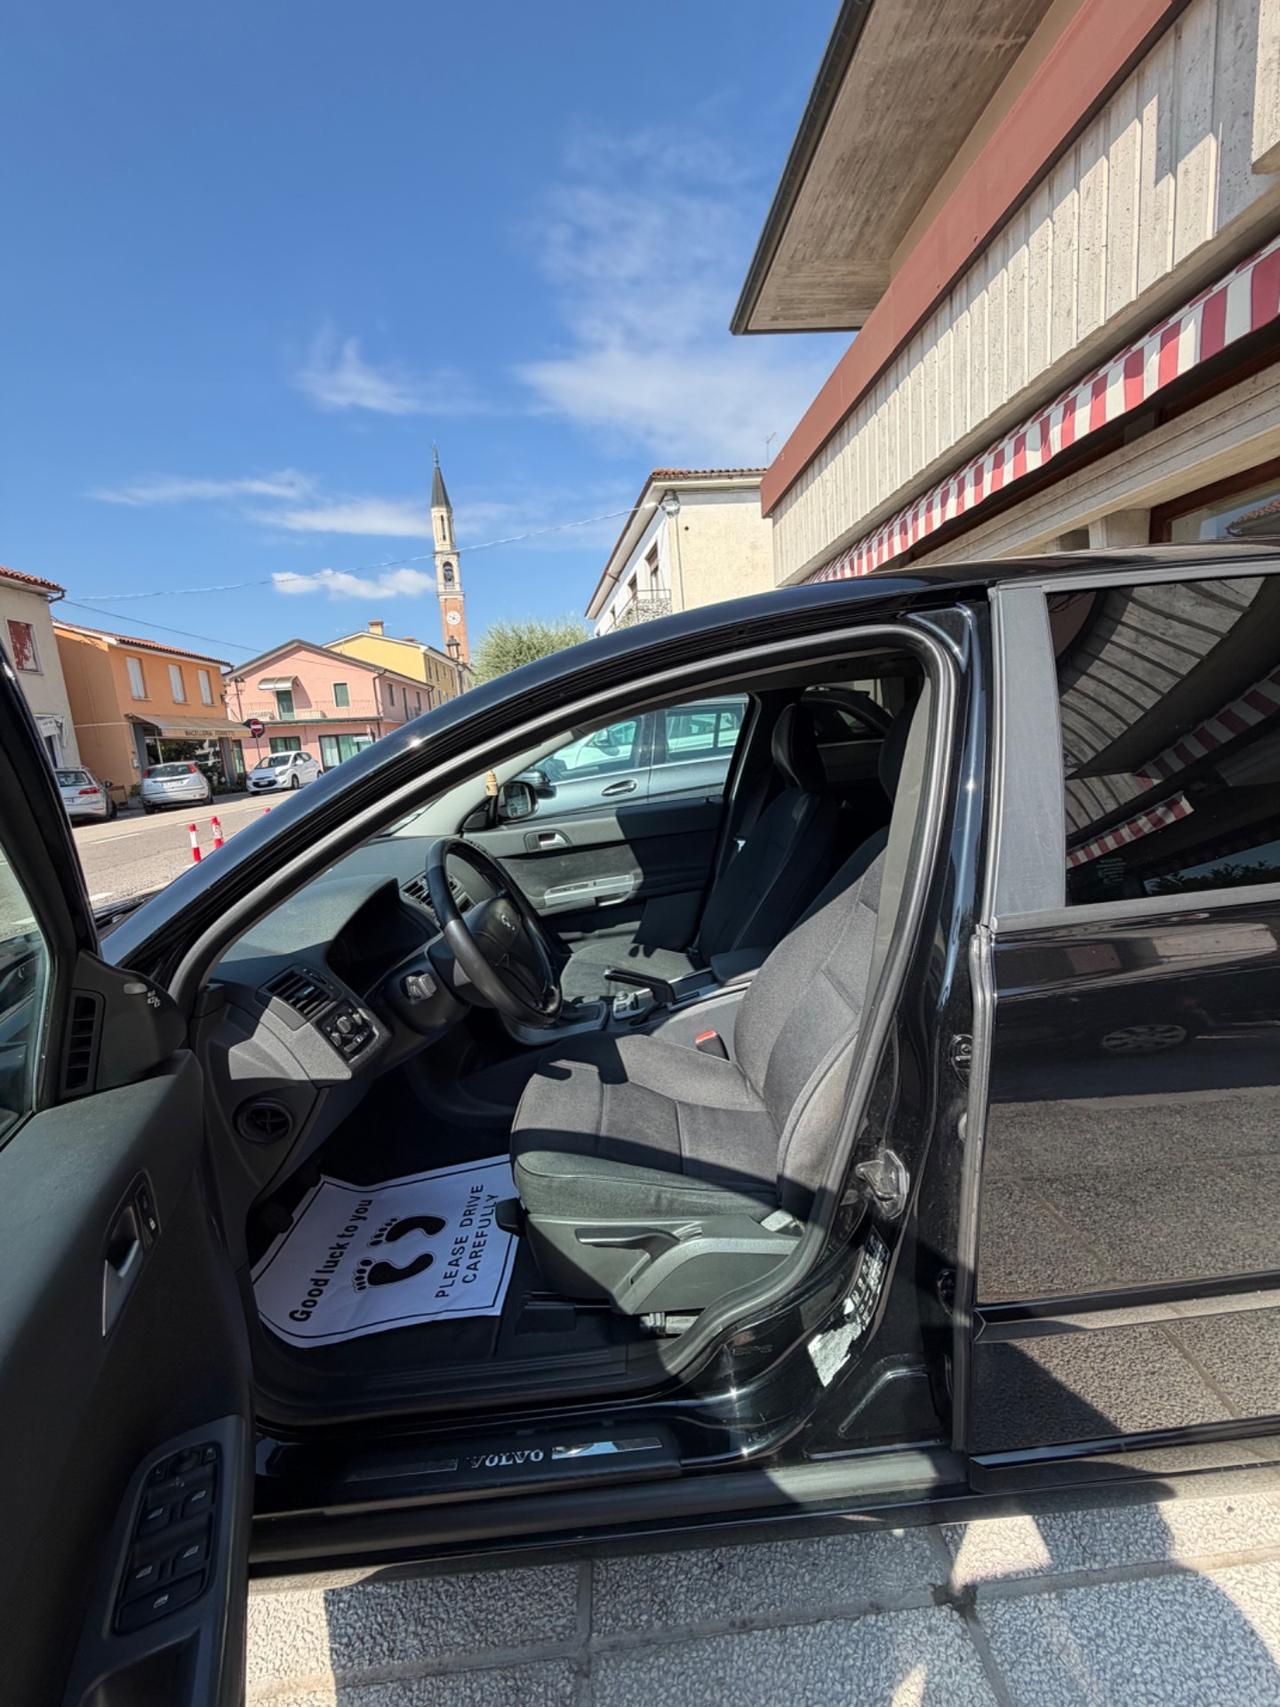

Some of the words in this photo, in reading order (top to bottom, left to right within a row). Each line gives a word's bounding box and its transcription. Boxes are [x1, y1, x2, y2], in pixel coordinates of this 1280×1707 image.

[288, 1277, 331, 1323] Good
[315, 1242, 350, 1274] luck
[337, 1225, 359, 1241] to
[350, 1199, 373, 1222] you
[435, 1235, 469, 1298] PLEASE
[459, 1184, 484, 1228] DRIVE
[462, 1194, 498, 1283] CAREFULLY
[465, 1448, 544, 1469] VOLVO
